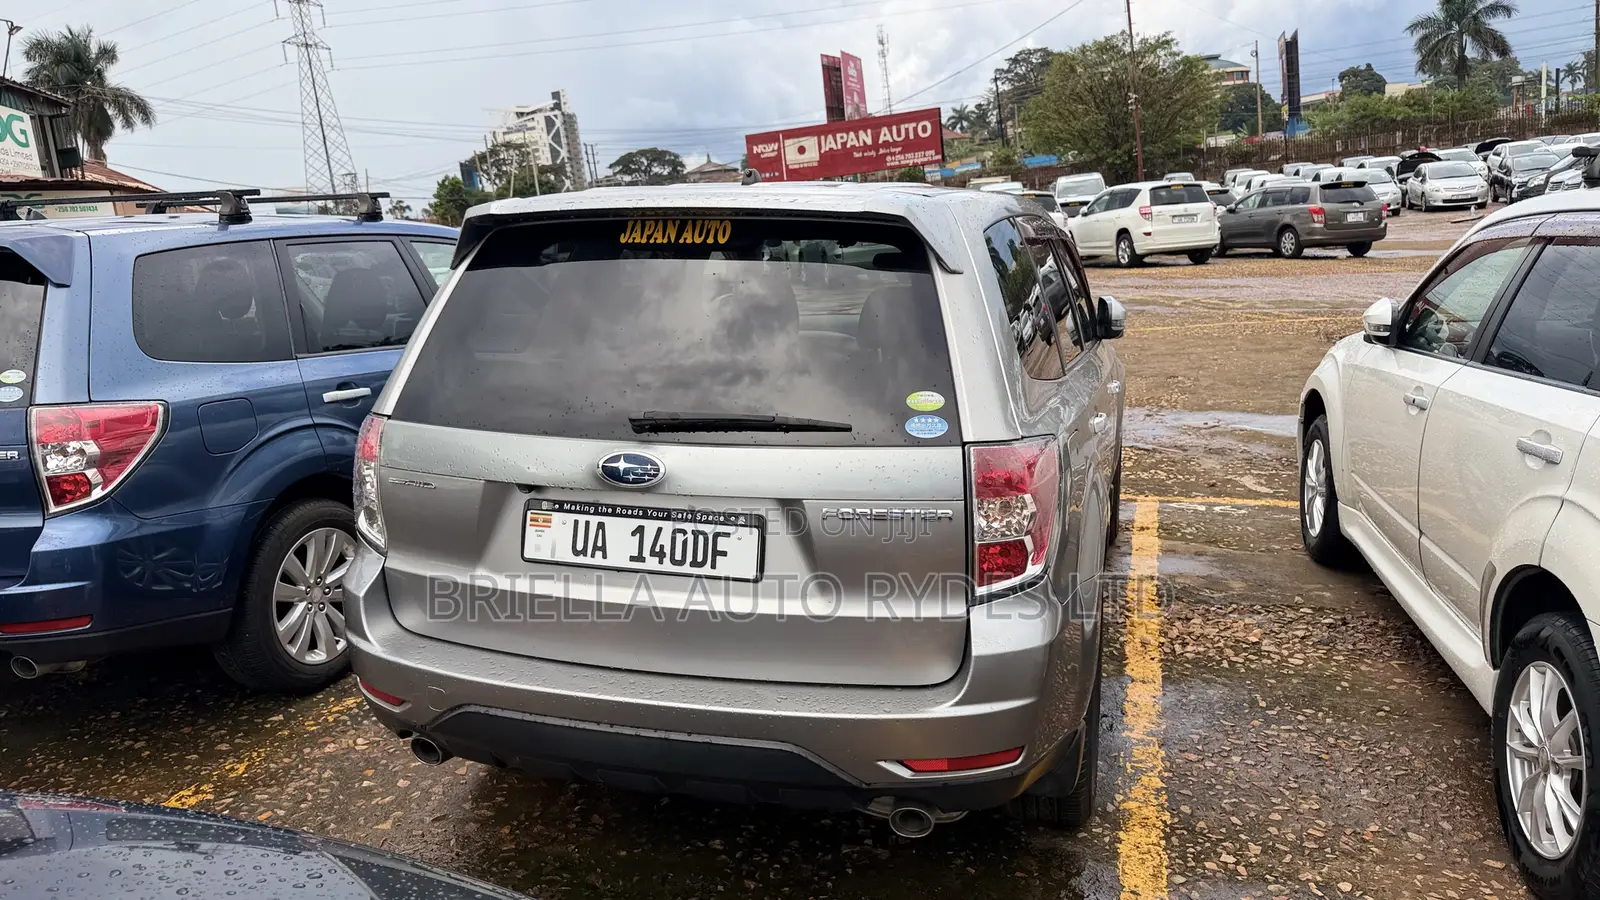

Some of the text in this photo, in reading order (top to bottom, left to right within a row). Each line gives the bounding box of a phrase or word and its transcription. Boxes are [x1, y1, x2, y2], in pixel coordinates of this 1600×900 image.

[752, 142, 779, 154] NOW
[820, 120, 932, 154] JAPAN AUTO
[620, 220, 732, 245] JAPAN AUTO
[563, 502, 595, 514] Making
[598, 505, 613, 514] the
[616, 507, 643, 517] Roads
[646, 509, 668, 519] Your
[671, 511, 692, 520] Safe
[695, 513, 725, 524] Space
[822, 507, 954, 521] FORESTER
[571, 519, 732, 570] UA 140DF
